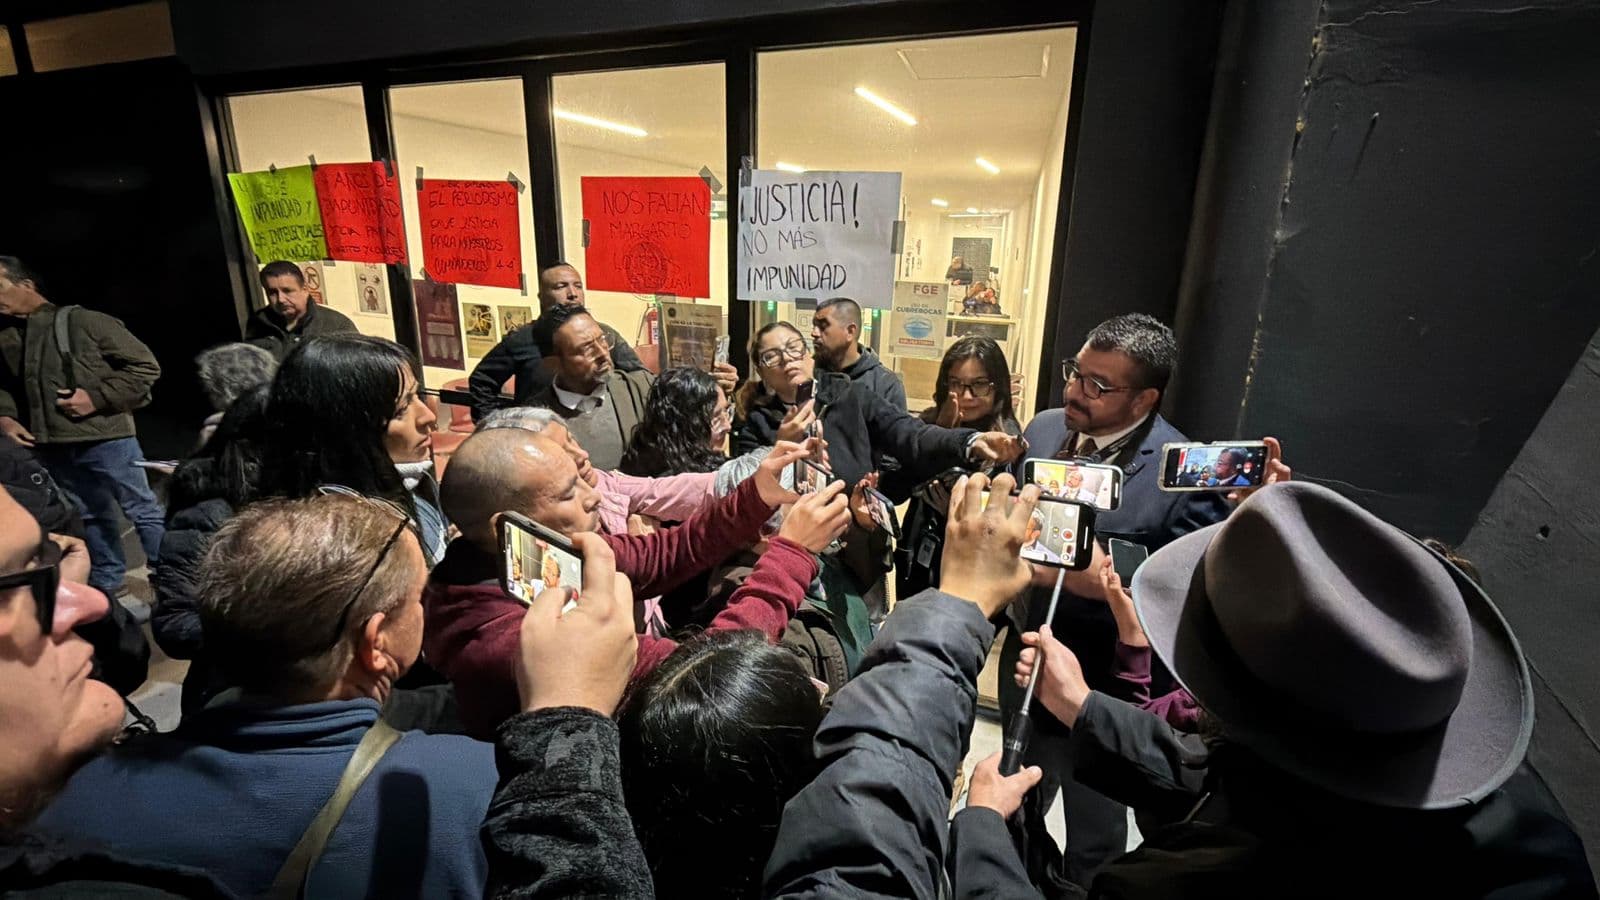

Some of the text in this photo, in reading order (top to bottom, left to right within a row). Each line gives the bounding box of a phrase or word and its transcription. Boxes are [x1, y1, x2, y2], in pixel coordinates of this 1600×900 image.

[603, 190, 706, 217] NOS FALTAN
[743, 226, 818, 257] NO MÁS
[747, 263, 847, 292] IMPUNIDAD
[912, 284, 939, 295] FGE
[896, 306, 942, 316] CUBREBOCAS
